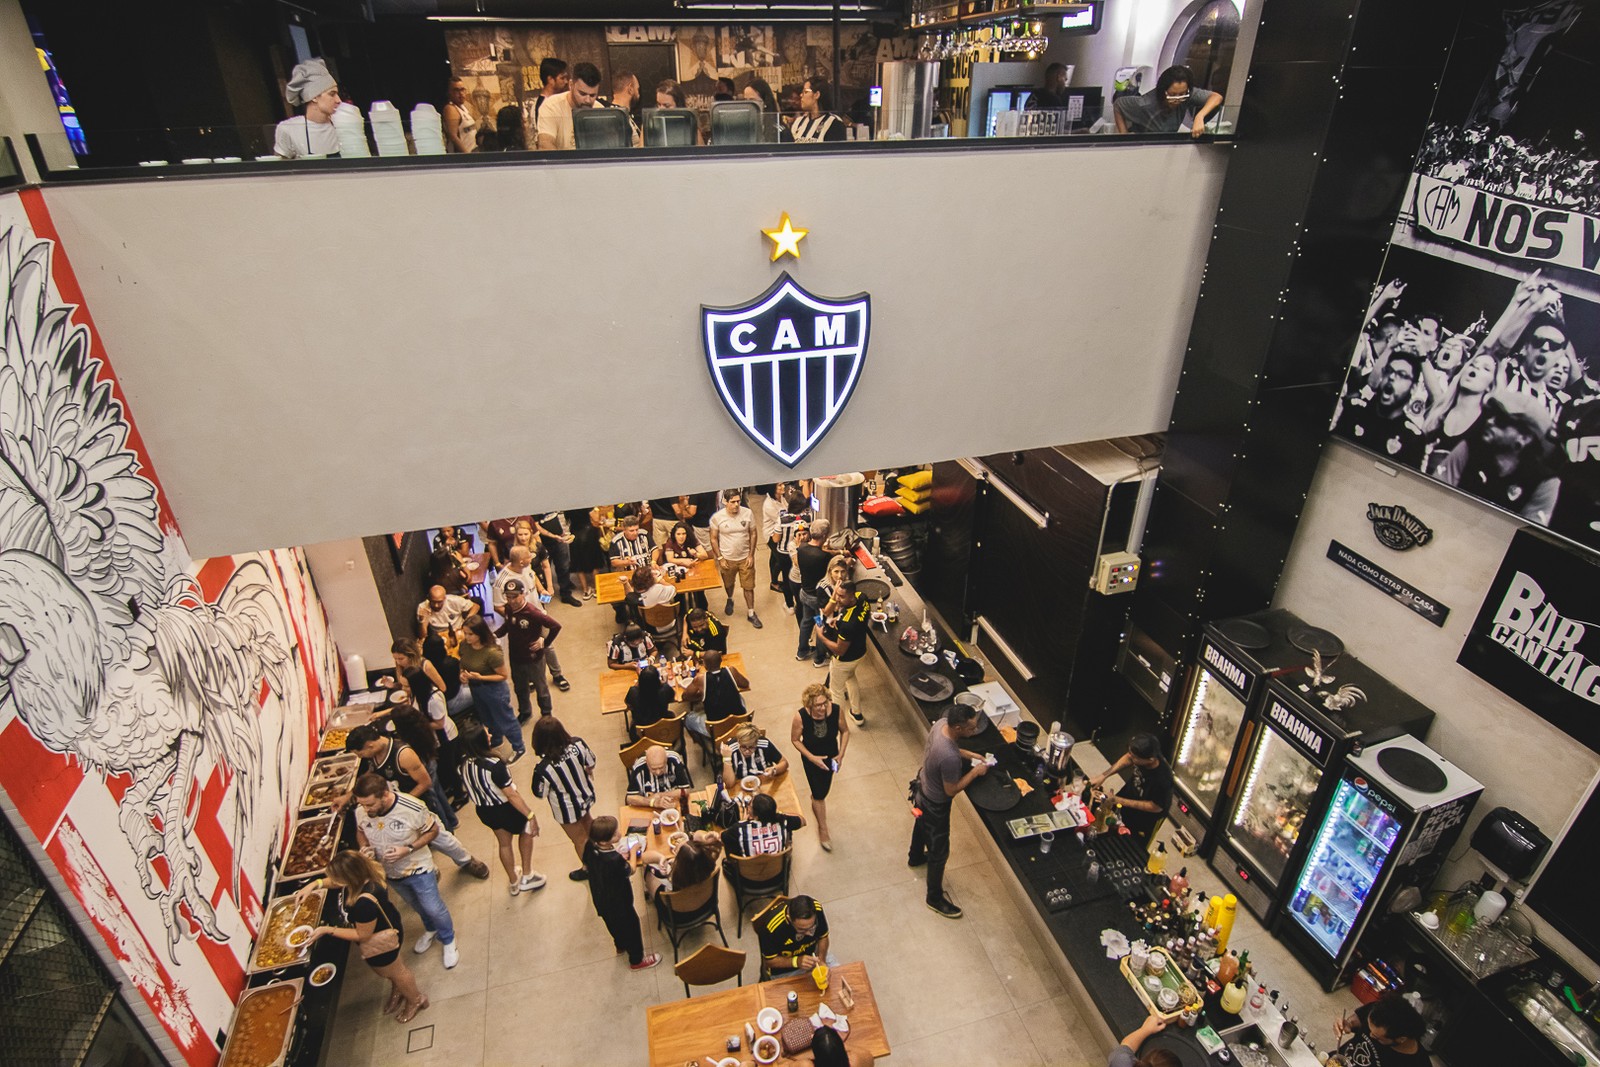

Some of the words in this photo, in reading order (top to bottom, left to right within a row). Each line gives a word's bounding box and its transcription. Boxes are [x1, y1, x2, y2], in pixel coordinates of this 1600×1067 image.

[1463, 191, 1570, 260] NOS
[729, 314, 846, 353] CAM
[1338, 550, 1356, 565] NADA
[1357, 561, 1379, 578] COMO
[1379, 574, 1402, 591] ESTAR
[1401, 588, 1414, 600] EM
[1413, 596, 1435, 612] CASA
[1492, 570, 1586, 652] BAR
[1204, 644, 1246, 690] BRAHMA
[1270, 701, 1322, 754] BRAHMA
[1368, 790, 1397, 813] pepsi
[1424, 804, 1465, 829] PEPSI
[1419, 812, 1465, 839] BLACK
